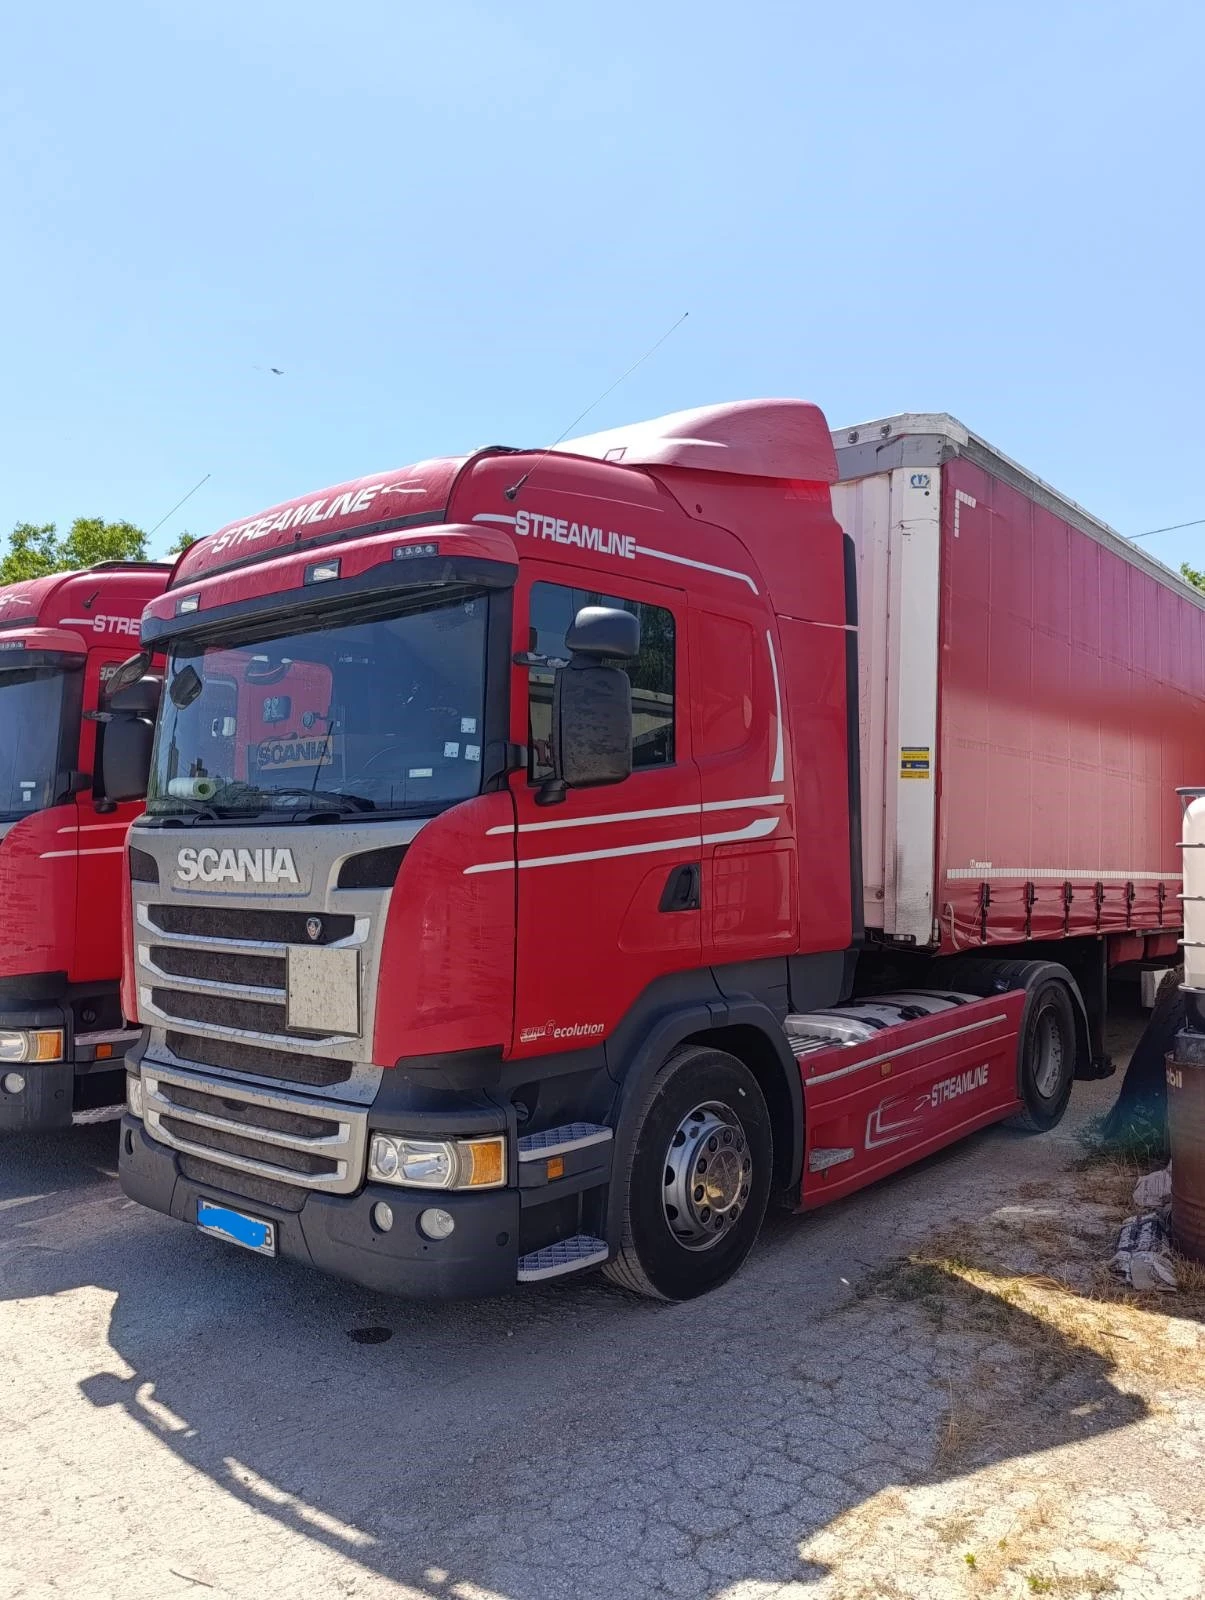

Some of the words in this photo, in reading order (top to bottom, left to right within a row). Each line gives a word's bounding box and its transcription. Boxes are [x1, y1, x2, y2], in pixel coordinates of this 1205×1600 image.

[211, 483, 385, 553] STREAMLINE
[515, 510, 637, 560] STREAMLINE
[93, 615, 141, 635] STRE
[256, 739, 331, 767] SCANIA
[177, 847, 300, 883] SCANIA
[554, 1023, 604, 1038] ecolution
[931, 1063, 989, 1108] STREAMLINE
